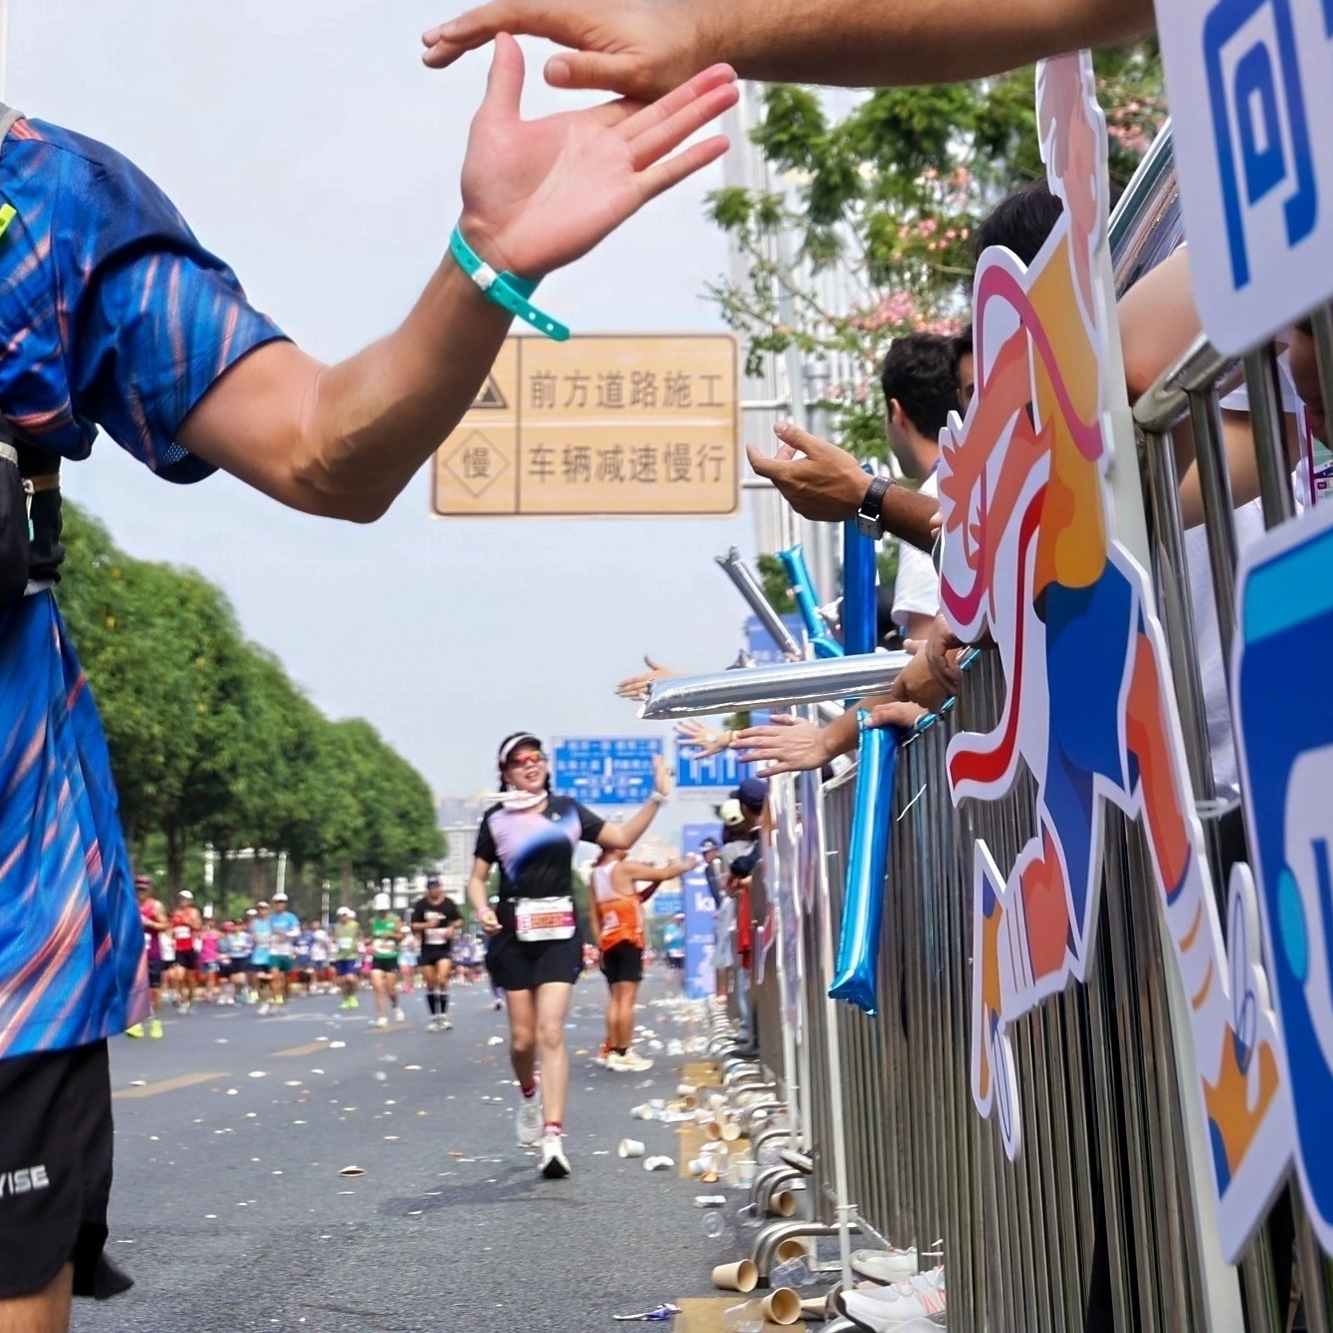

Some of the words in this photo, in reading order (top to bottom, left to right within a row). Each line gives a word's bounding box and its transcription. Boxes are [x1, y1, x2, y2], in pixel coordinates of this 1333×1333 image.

[529, 370, 725, 410] 前方道路施工
[462, 447, 491, 480] 慢
[528, 443, 726, 483] 车辆减速慢行
